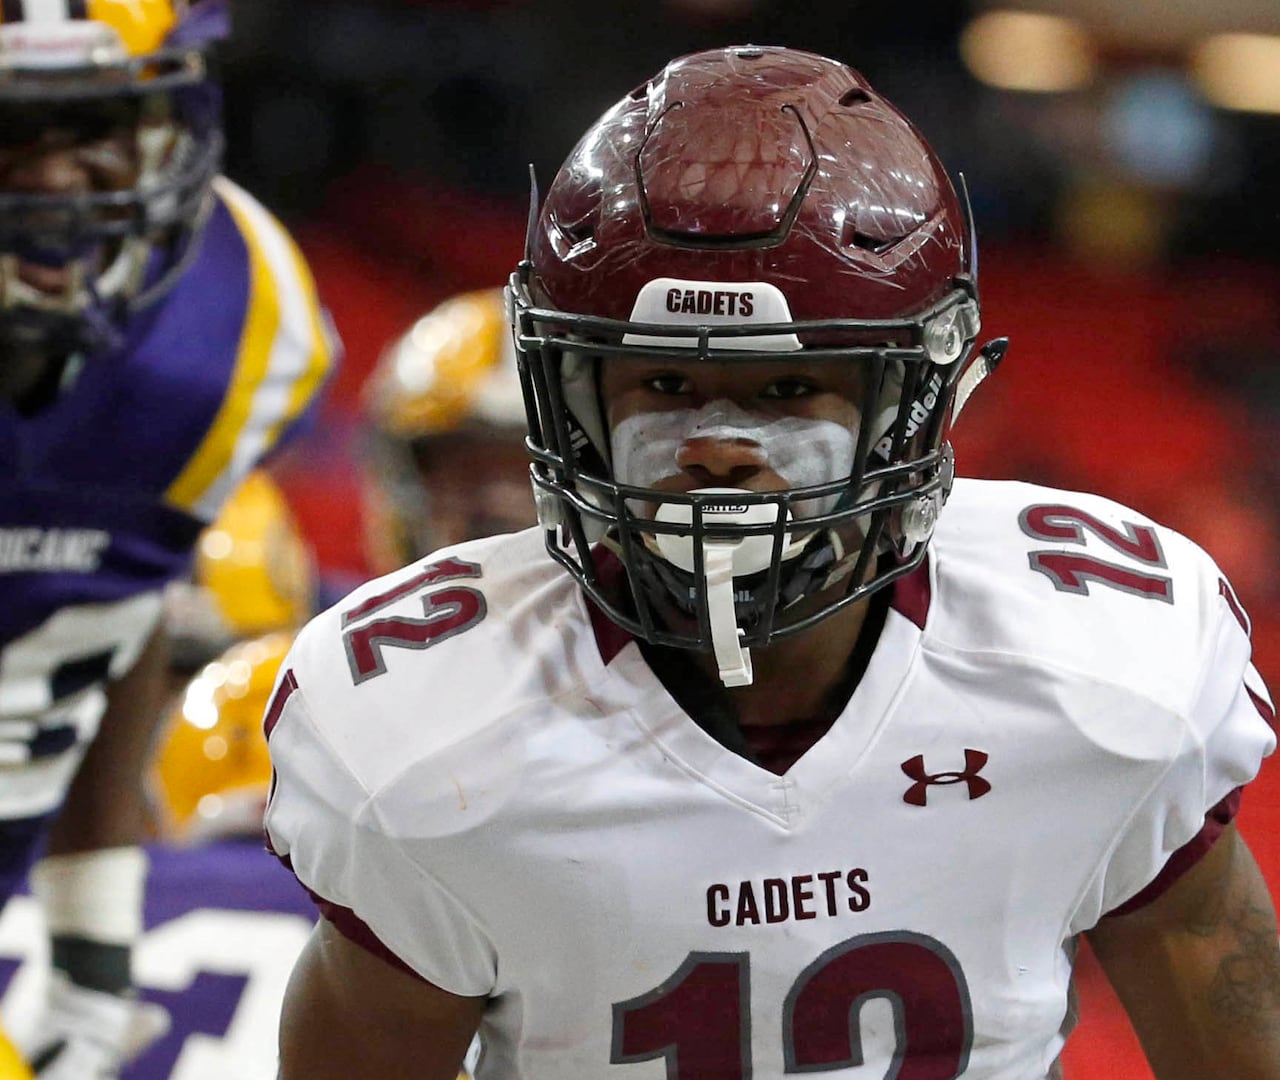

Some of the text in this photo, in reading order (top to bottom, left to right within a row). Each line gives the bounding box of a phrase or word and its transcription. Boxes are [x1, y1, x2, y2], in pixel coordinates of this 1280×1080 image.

[666, 288, 754, 317] CADETS
[873, 371, 943, 462] Rddell
[1017, 503, 1175, 606] 12
[341, 556, 488, 687] 12
[706, 867, 871, 927] CADETS
